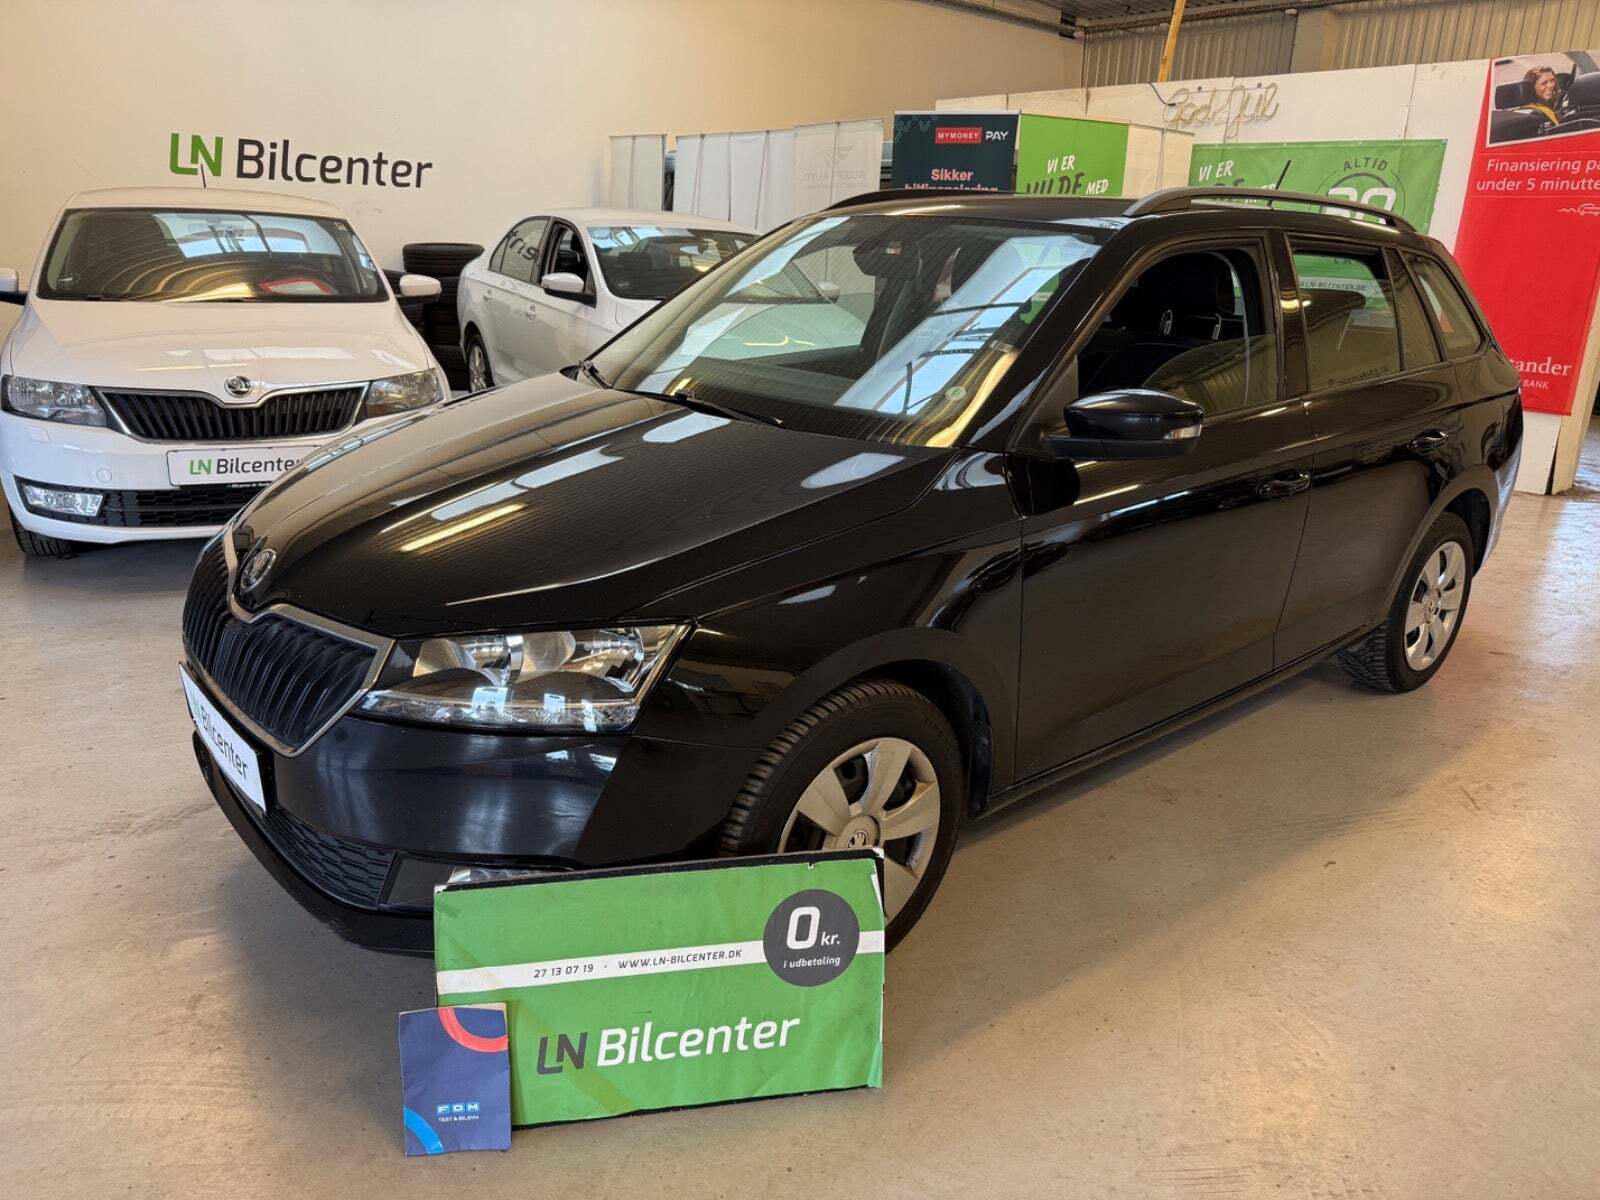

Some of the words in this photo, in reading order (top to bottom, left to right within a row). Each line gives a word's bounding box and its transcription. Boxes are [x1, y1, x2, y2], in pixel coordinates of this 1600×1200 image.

[937, 131, 980, 140] MYMONEY
[985, 130, 1009, 141] PAY
[169, 133, 223, 177] LN
[236, 138, 433, 188] Bilcenter
[1047, 158, 1059, 174] VI
[1061, 155, 1076, 171] ER
[1343, 156, 1388, 172] ALTID
[1487, 157, 1582, 175] Finansiering
[931, 168, 974, 181] Sikker
[1199, 165, 1213, 182] VI
[1216, 160, 1234, 178] ER
[1086, 178, 1109, 195] MED
[1477, 177, 1522, 191] under
[1527, 177, 1536, 191] 5
[1523, 379, 1549, 390] BANK
[190, 459, 212, 475] LN
[216, 456, 299, 475] Bilcente
[201, 704, 248, 780] Bilcenter
[786, 906, 820, 950] 0
[820, 931, 841, 947] kr.
[534, 968, 547, 979] 27
[551, 967, 561, 977] 13
[565, 965, 579, 975] 07
[584, 963, 594, 973] 19
[618, 949, 743, 970] WWW.LN-BILCENTER.DK
[789, 956, 841, 969] udbetaling
[536, 1032, 588, 1075] LN
[597, 1016, 800, 1067] Bilcenter
[437, 1103, 479, 1114] FDM
